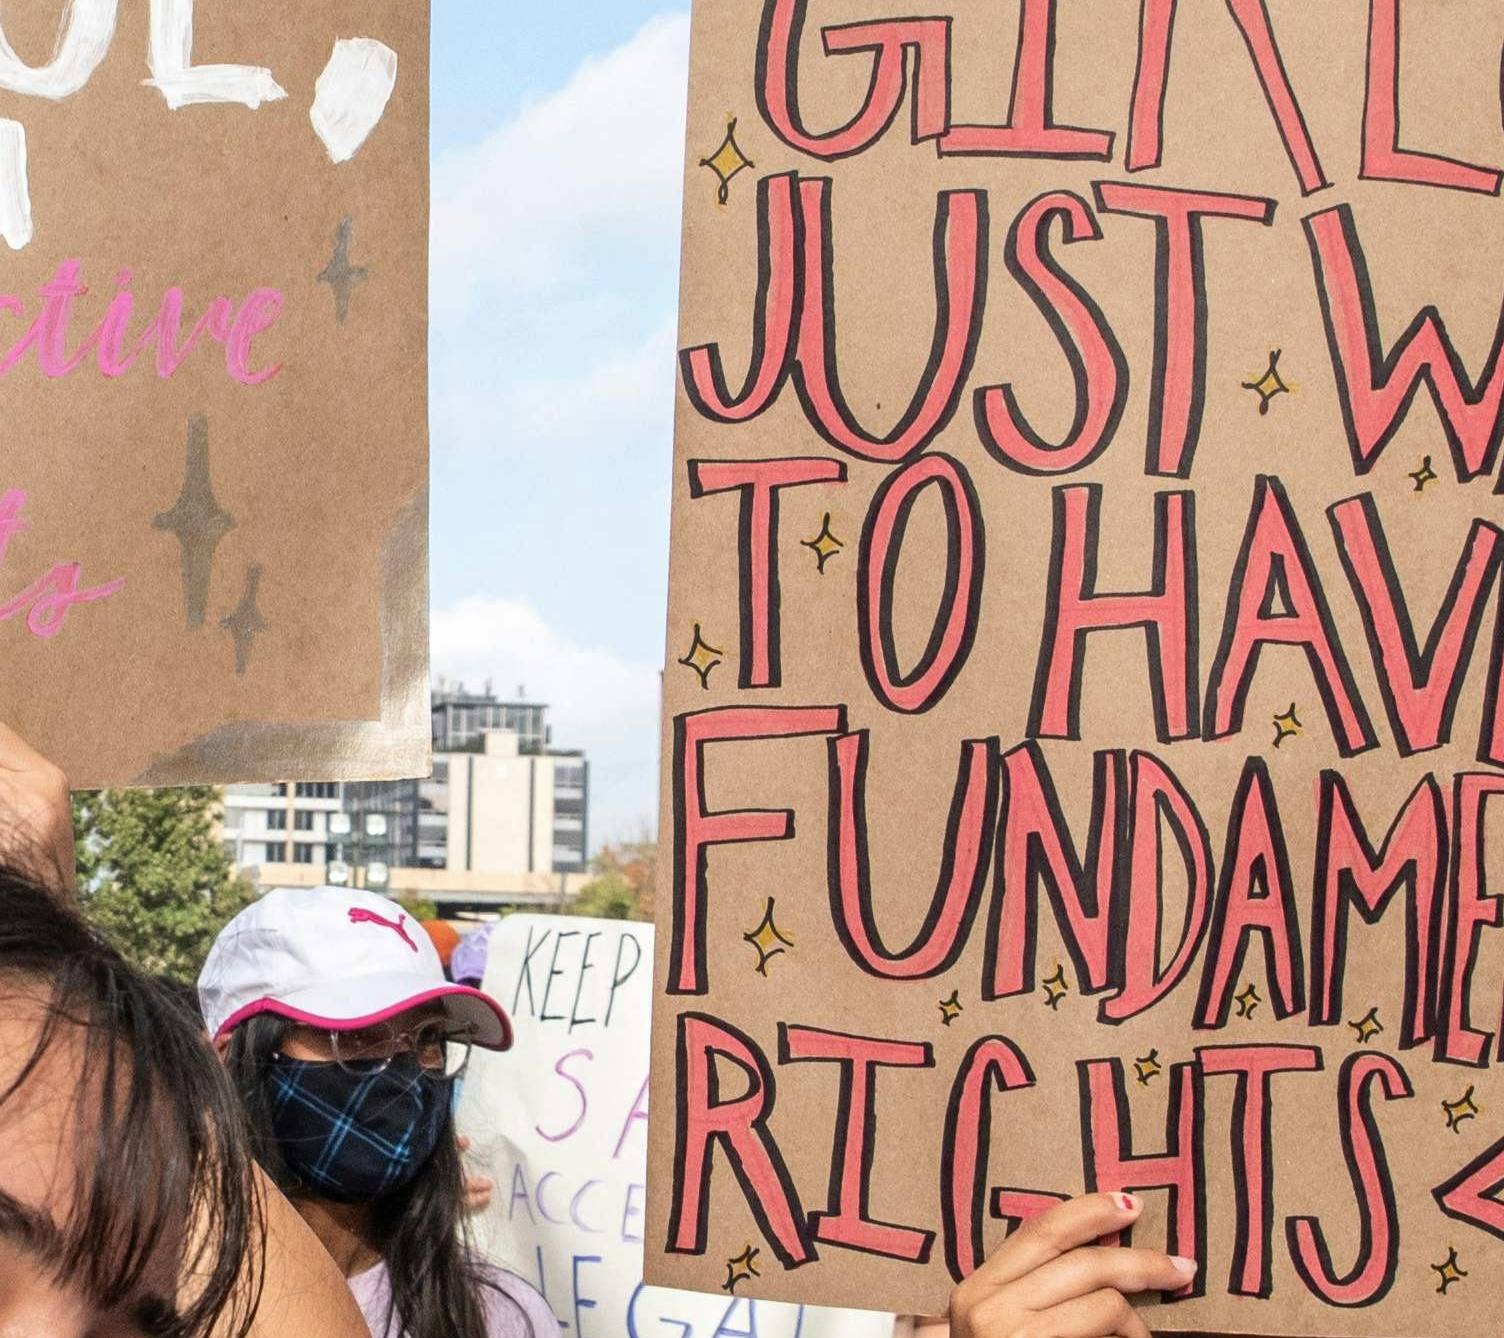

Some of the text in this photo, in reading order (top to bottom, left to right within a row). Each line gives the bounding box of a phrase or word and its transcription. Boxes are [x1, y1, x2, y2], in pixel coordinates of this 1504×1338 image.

[679, 170, 1277, 477] JUST
[689, 453, 986, 714] TO
[511, 925, 642, 1036] KEEP
[664, 1011, 1415, 1309] RIGHTS
